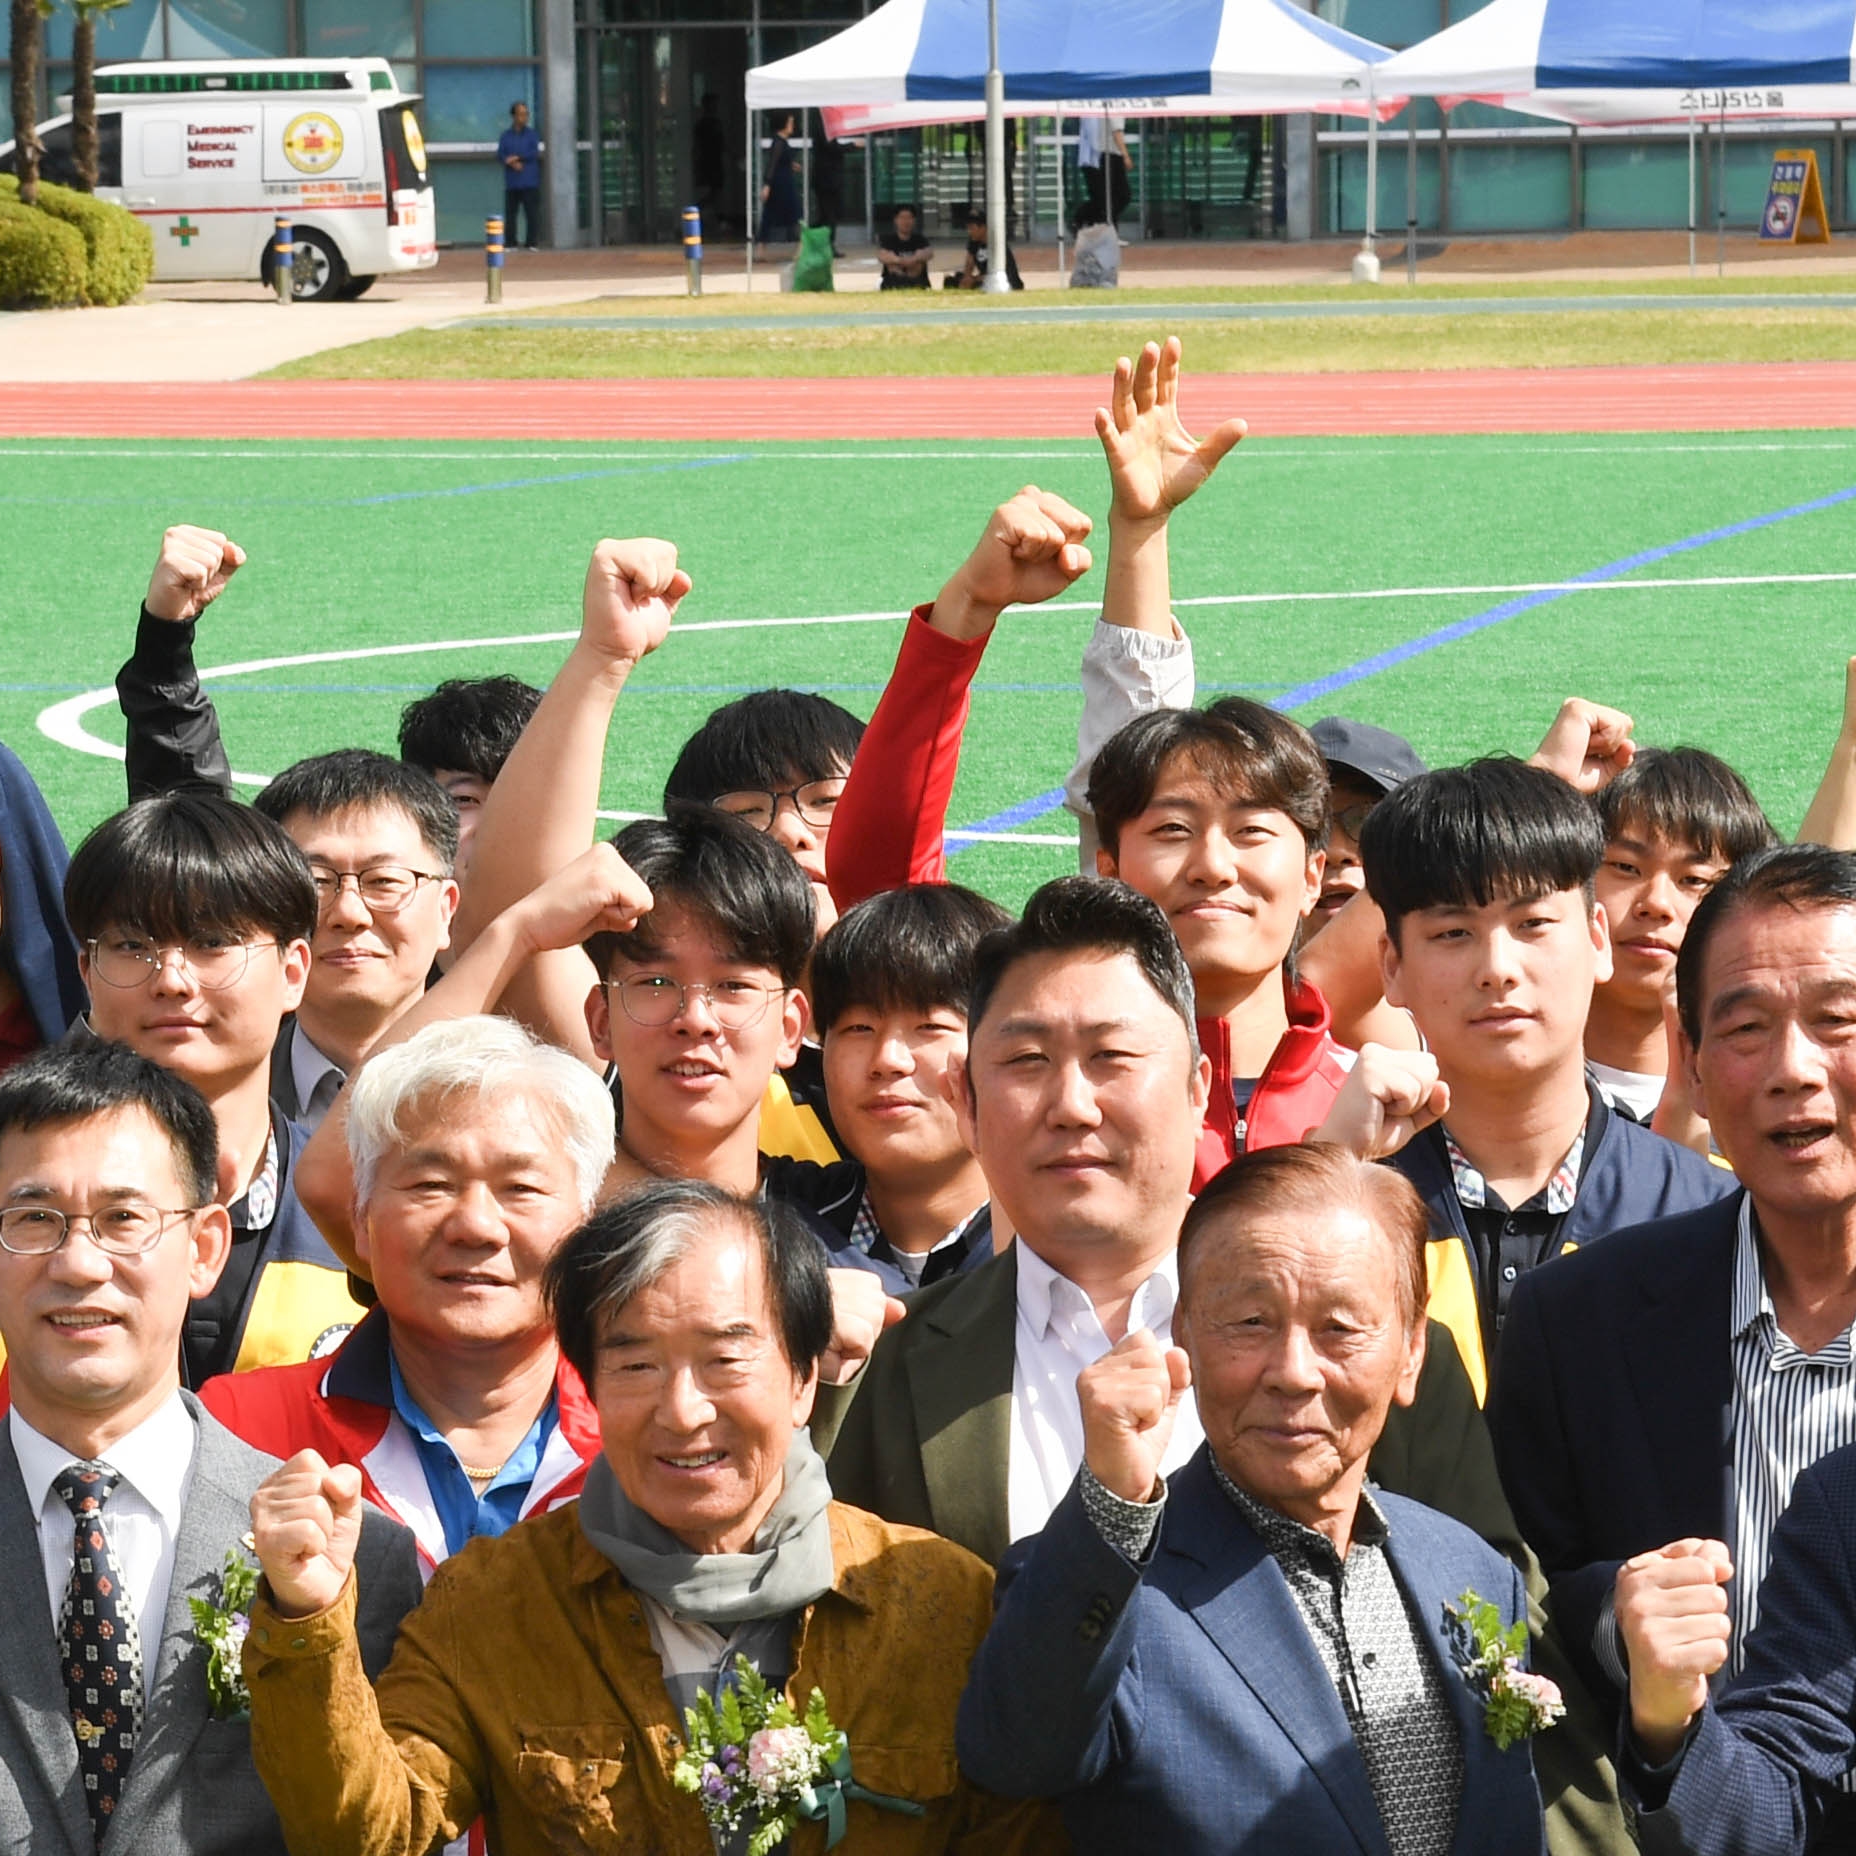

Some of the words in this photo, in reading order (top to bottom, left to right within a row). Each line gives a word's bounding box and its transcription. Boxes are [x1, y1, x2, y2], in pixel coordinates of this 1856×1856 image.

[187, 124, 254, 135] EMERGENCY
[187, 140, 237, 152] MEDICAL
[187, 156, 234, 169] SERVICE
